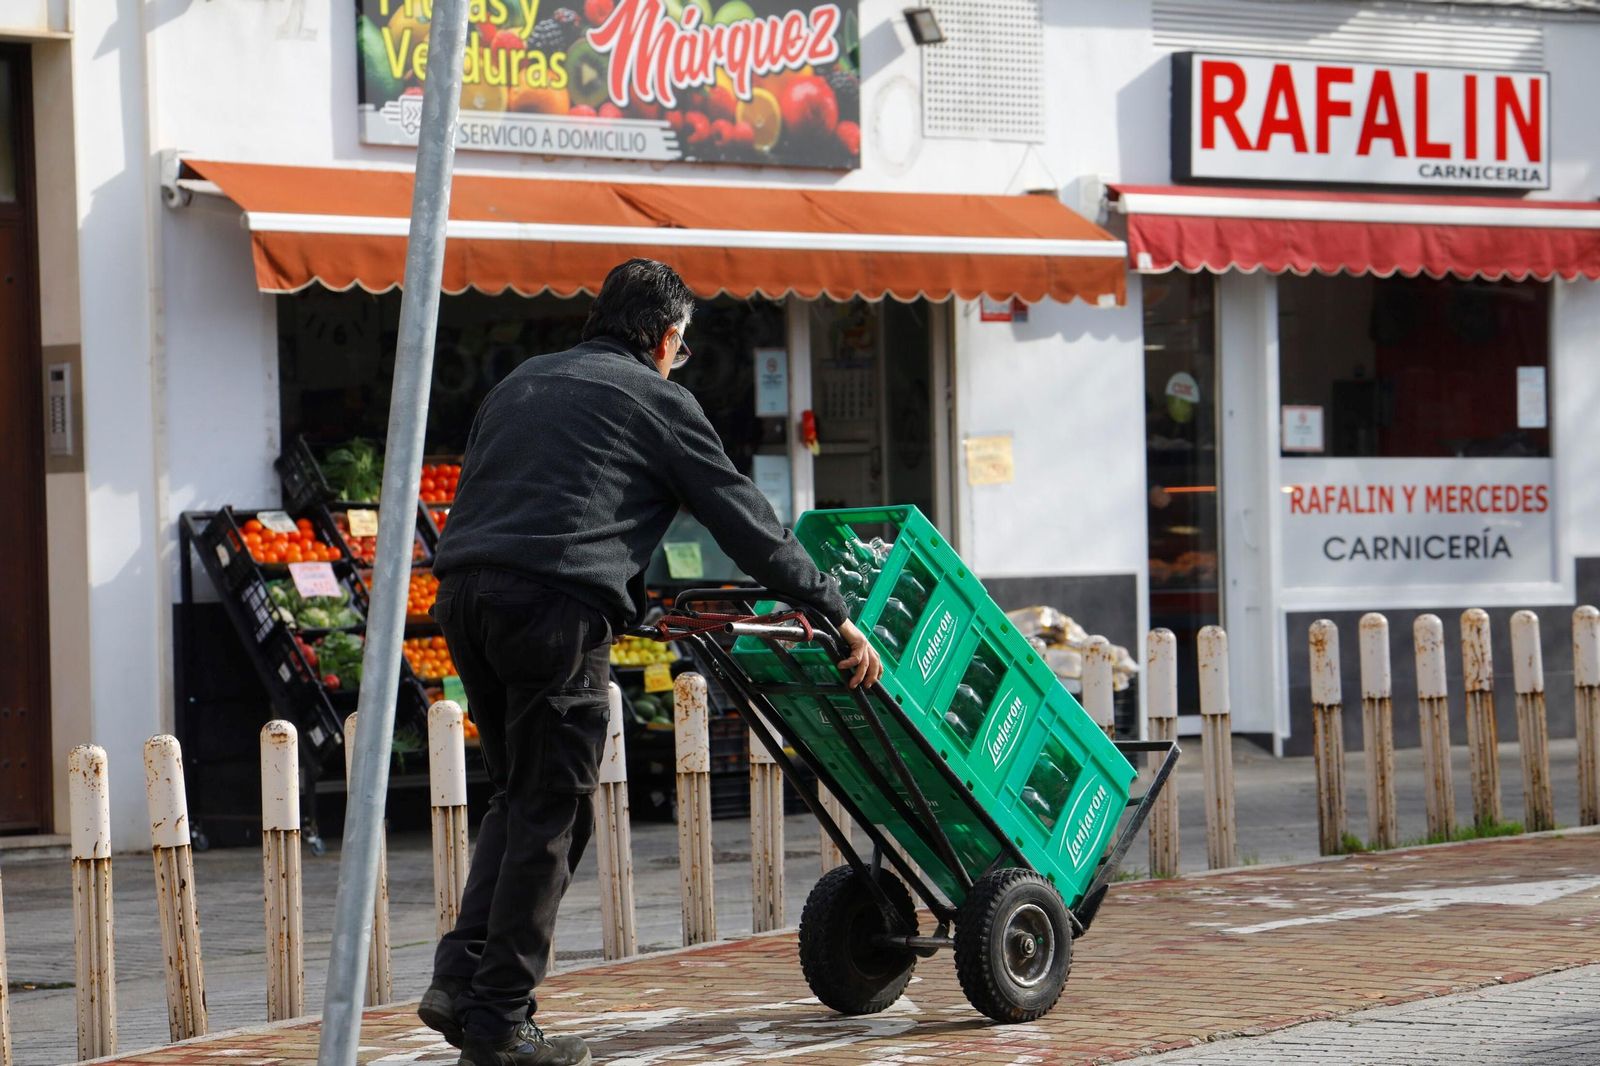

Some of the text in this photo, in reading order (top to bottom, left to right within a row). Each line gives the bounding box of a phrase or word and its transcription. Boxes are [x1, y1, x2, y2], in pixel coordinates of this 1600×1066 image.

[381, 27, 569, 89] Veduras
[587, 0, 840, 107] Márquez
[1201, 60, 1542, 163] RAFALIN
[459, 123, 647, 153] SERVICIO A DOMICILIO
[1418, 163, 1542, 182] CARNICERIA
[1291, 484, 1549, 514] RAFALIN Y MERCEDES
[1323, 526, 1512, 561] CARNICERÍA
